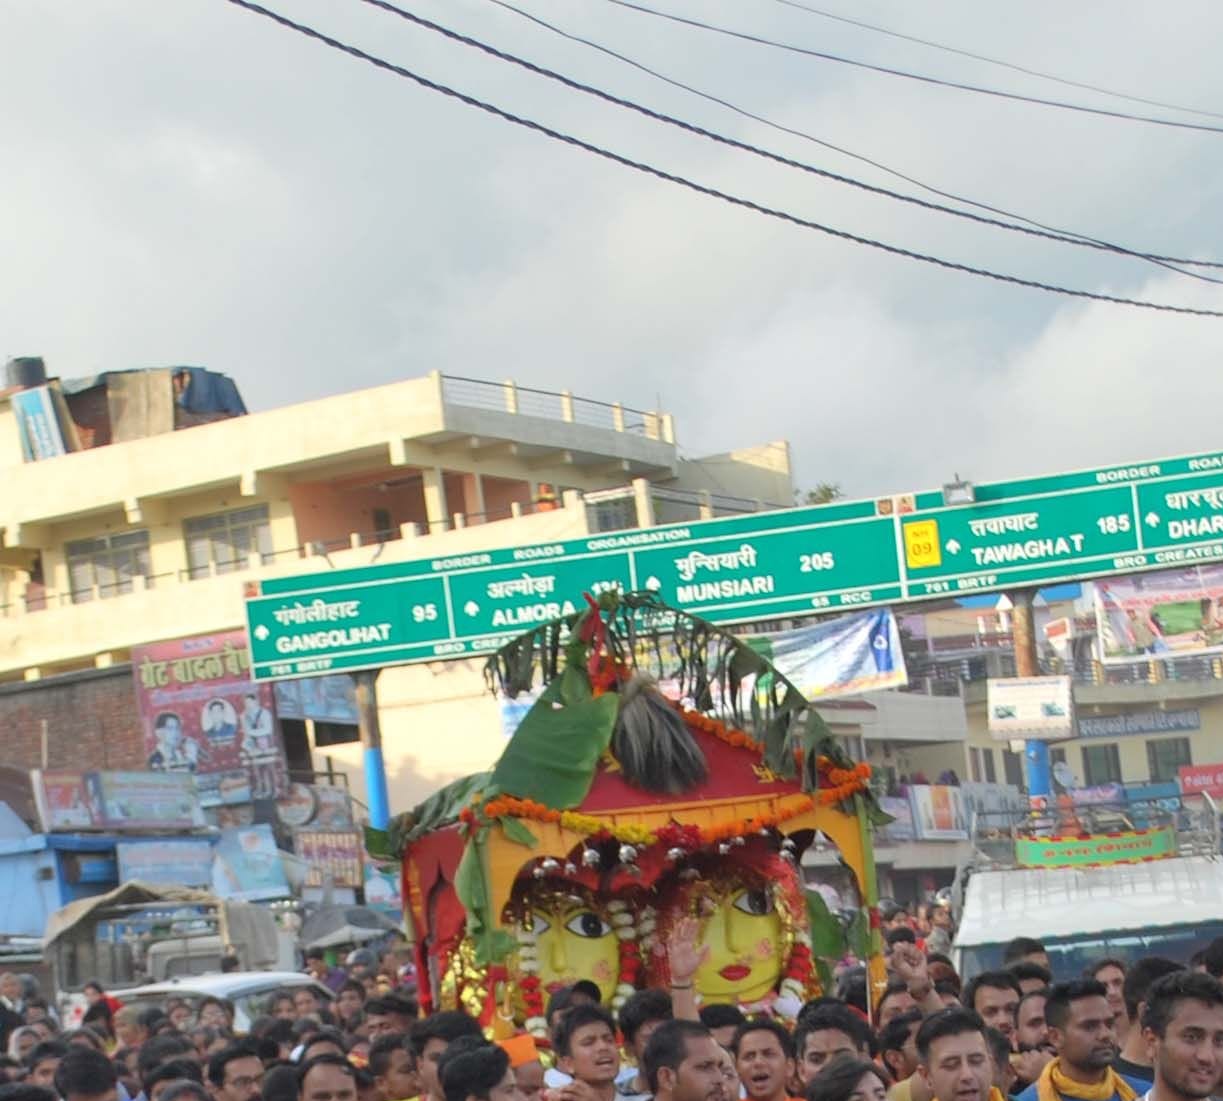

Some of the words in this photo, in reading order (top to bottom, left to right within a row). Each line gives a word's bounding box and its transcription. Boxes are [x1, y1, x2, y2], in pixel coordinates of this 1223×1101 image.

[1096, 465, 1161, 483] BORDER
[969, 513, 1038, 537] तवाघाट
[1097, 515, 1130, 534] 185
[431, 554, 491, 571] BORDER
[514, 544, 565, 560] ROADS
[587, 528, 691, 551] ORGANISATION
[800, 552, 835, 572] 205
[912, 543, 932, 556] 09
[971, 534, 1085, 565] TAWAGHAT
[488, 573, 555, 599] अल्मोड़ा
[924, 581, 949, 594] 761
[958, 575, 997, 591] BRTF
[1114, 555, 1148, 570] BRO
[677, 575, 775, 603] MUNSIARI
[273, 600, 360, 624] गंगोलीहाट
[412, 604, 437, 623] 95
[434, 641, 465, 656] BRO
[841, 591, 872, 605] RCC
[492, 601, 576, 626] ALMORA
[276, 623, 392, 653] GANGOLIHAT
